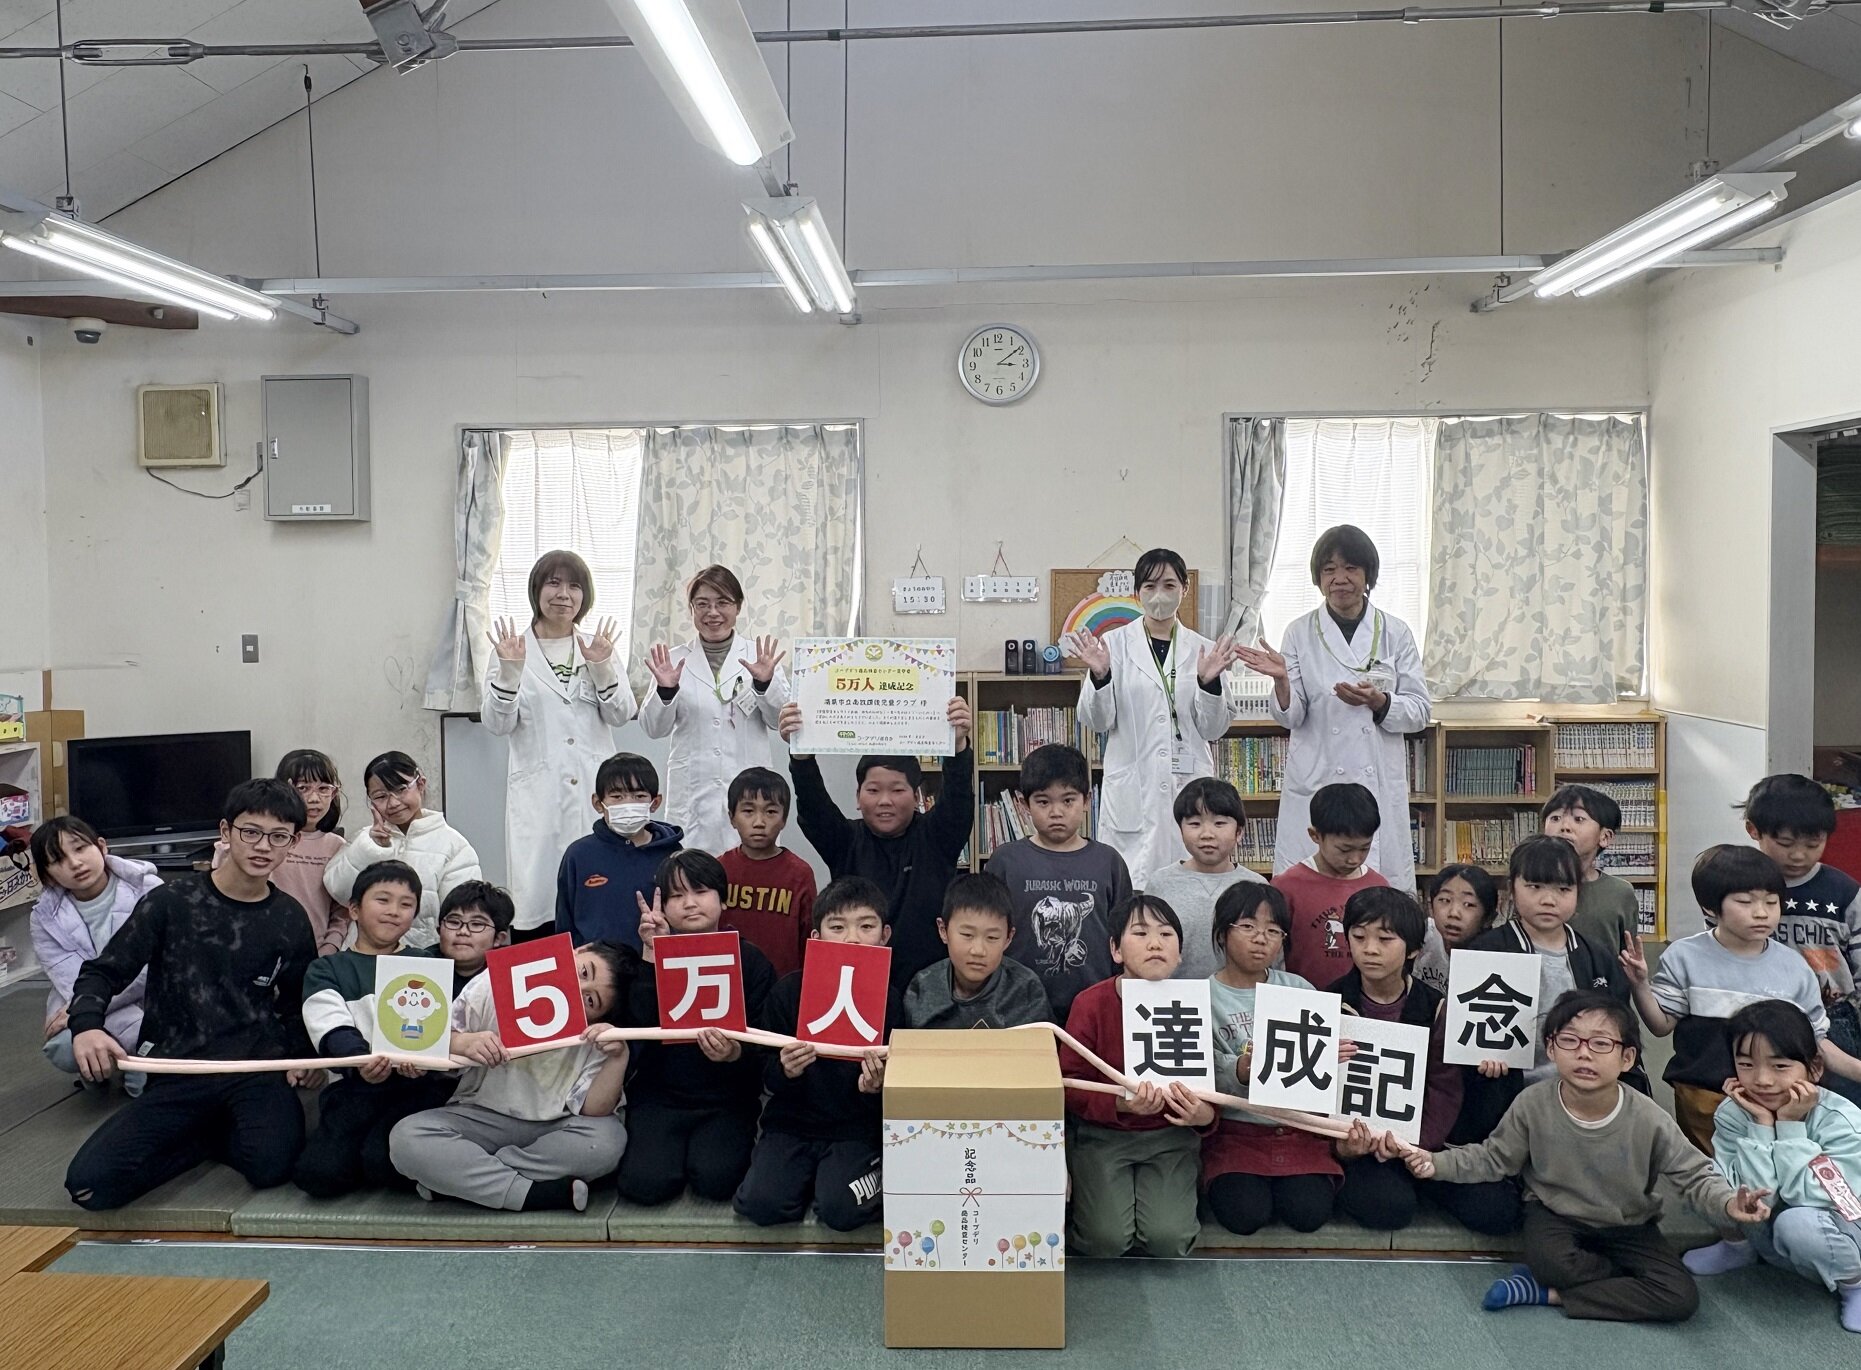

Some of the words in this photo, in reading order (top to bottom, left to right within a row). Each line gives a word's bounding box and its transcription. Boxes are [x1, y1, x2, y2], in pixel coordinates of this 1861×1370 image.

[982, 337, 990, 347] 11
[993, 333, 1003, 344] 12
[973, 347, 983, 357] 10
[1018, 345, 1025, 356] 2
[969, 361, 977, 371] 9
[1022, 358, 1029, 369] 3
[974, 374, 982, 384] 8
[984, 383, 991, 393] 7
[996, 385, 1003, 395] 6
[1009, 382, 1016, 392] 5
[836, 677, 875, 692] 5万人
[879, 681, 914, 691] 達成記念
[1024, 879, 1061, 892] JURASSIC
[1063, 879, 1098, 892] WORLD
[726, 883, 793, 914] USTIN
[662, 954, 735, 1022] 万
[511, 957, 570, 1039] 5
[806, 965, 880, 1043] 人
[1457, 973, 1533, 1050] 念
[1130, 1000, 1207, 1077] 達
[1257, 1008, 1333, 1090] 成
[1341, 1040, 1416, 1123] 記
[964, 1147, 977, 1184] 記念品
[972, 1210, 980, 1245] コープデリ
